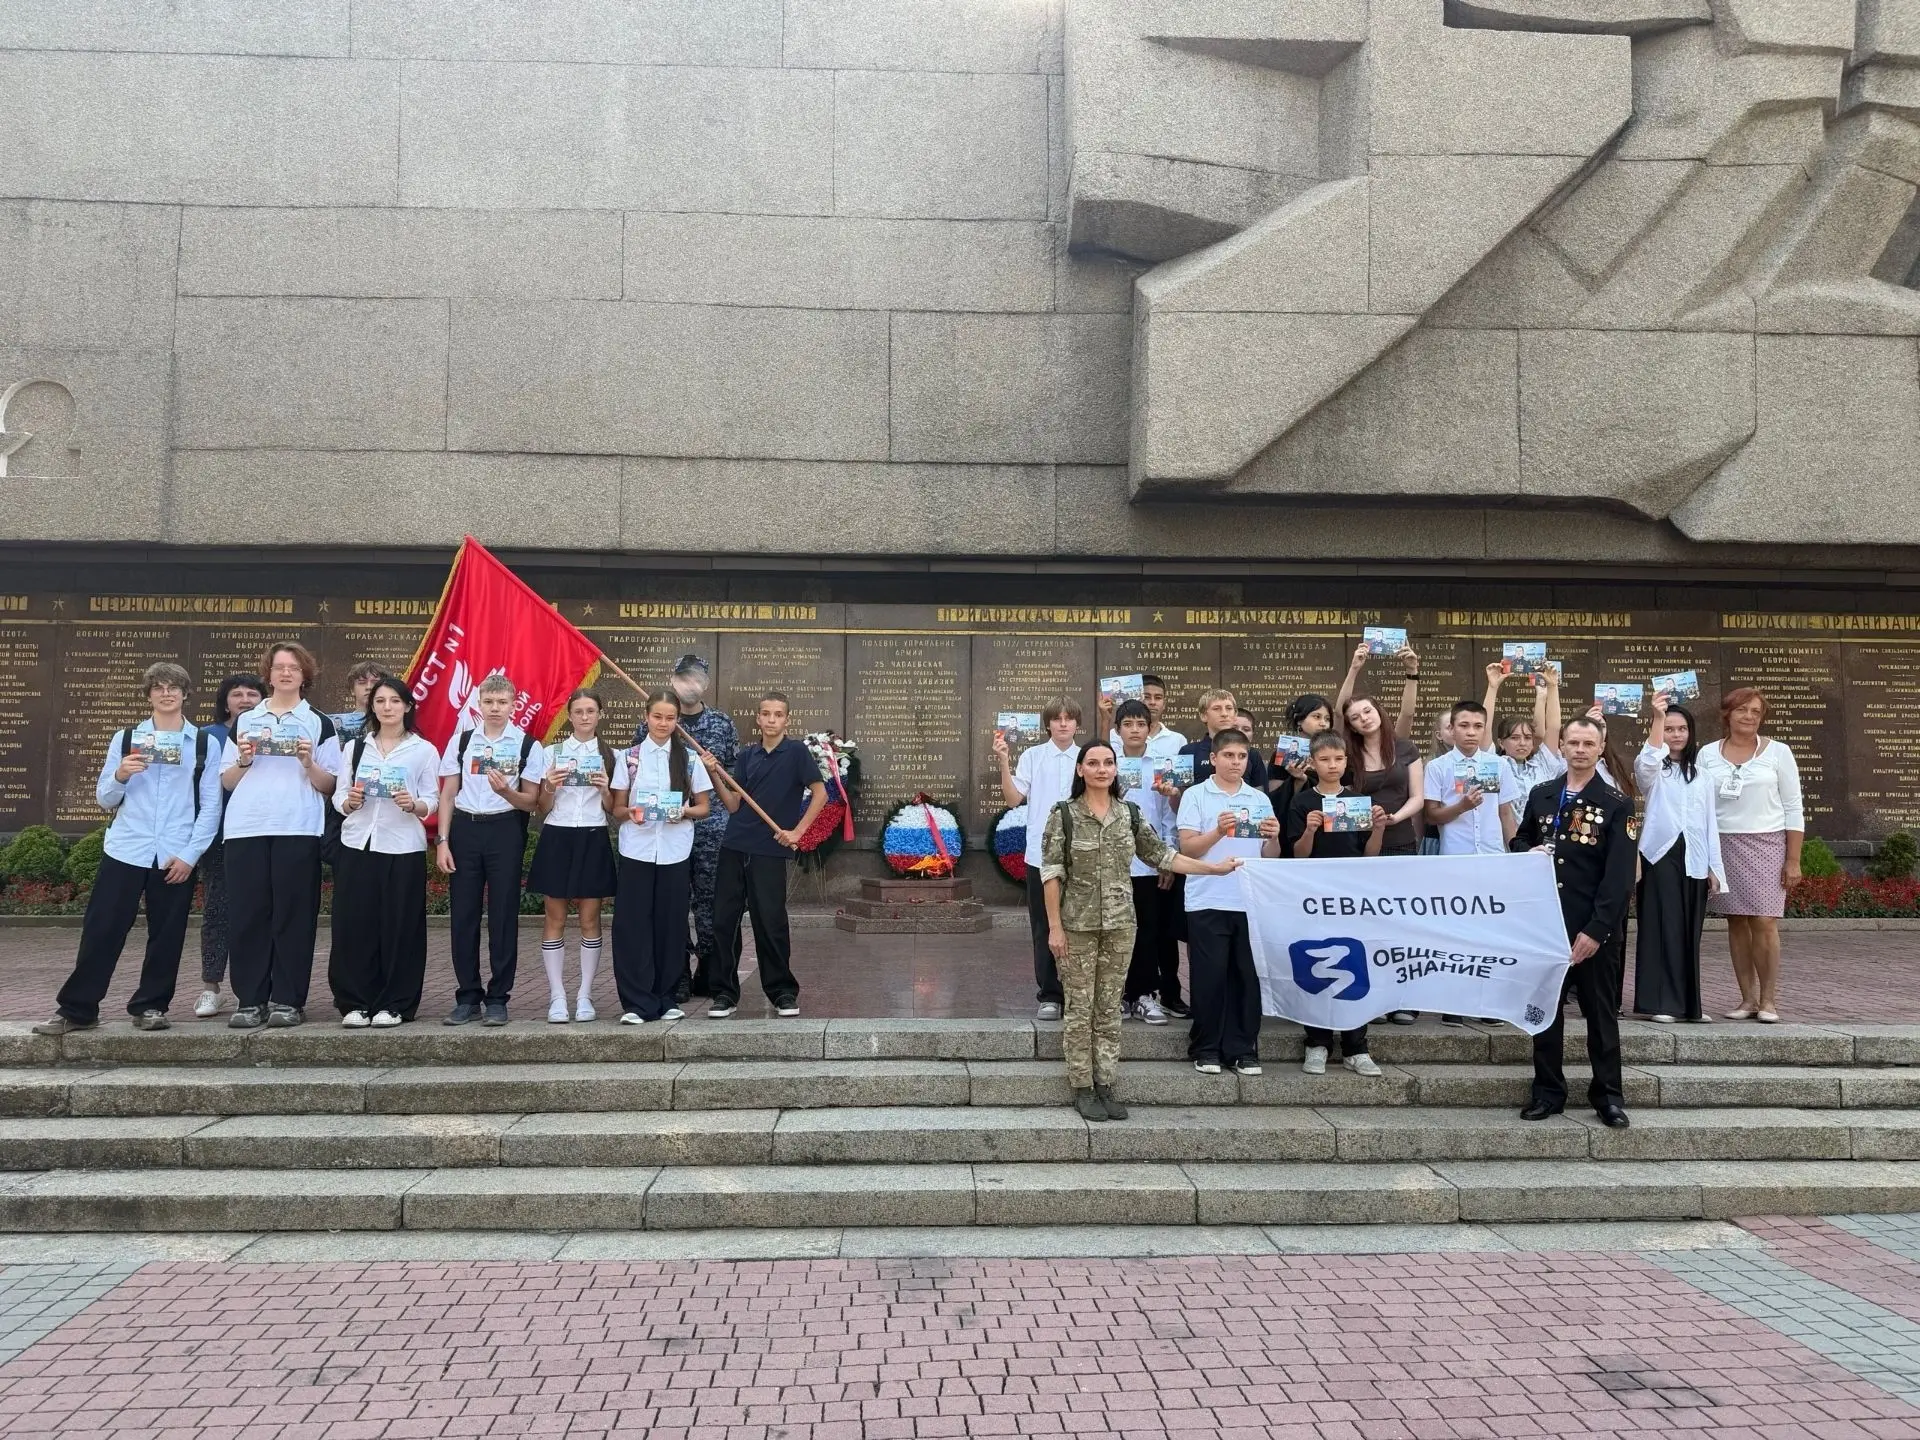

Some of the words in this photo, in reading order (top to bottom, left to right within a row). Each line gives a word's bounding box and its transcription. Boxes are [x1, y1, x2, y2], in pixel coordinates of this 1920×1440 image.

[93, 597, 234, 613] ЧЕРНОМОРСКИЙ
[245, 598, 291, 613] ФЛОТ
[357, 600, 439, 615] ЧЕРНОМ
[622, 604, 759, 619] ЧЕРНОМОРСКИЙ
[771, 606, 815, 620] ФЛОТ
[941, 608, 1054, 622] ПРИМОРСКАЯ
[1066, 609, 1127, 623] АРМИЯ
[1191, 610, 1305, 624] ПРИМОРСКАЯ
[1443, 611, 1557, 626] ПРИМОРСКАЯ
[1567, 612, 1627, 626] АРМИЯ
[1822, 615, 1920, 630] ОРГАНИЗАЦИ
[0, 630, 28, 638] ЕХОТА
[345, 633, 386, 641] КОРАБЛИ
[388, 633, 424, 641] ЭСКАДР
[608, 635, 697, 644] ГИДРОГРАФИЧЕСКИЙ
[110, 640, 135, 648] СИЛЫ
[862, 640, 898, 648] ПОЛЕВОЕ
[904, 640, 955, 648] УПРАВЛЕНИЕ
[1025, 640, 1074, 648] СТРЕЛКОВАЯ
[1140, 642, 1201, 650] СТРЕЛКОВАЯ
[1739, 647, 1784, 655] ГОРОДСКОЙ
[1137, 652, 1180, 660] ДИВИЗИЯ
[1262, 652, 1305, 660] ДИВИЗИЯ
[892, 661, 943, 669] ЧАПАЕВСКАЯ
[411, 651, 447, 710] ОСТ
[862, 678, 912, 686] СТРЕЛКОВАЯ
[607, 701, 646, 709] ОТДЕЛЬН
[893, 754, 943, 762] СТРЕЛКОВАЯ
[1302, 895, 1506, 916] СЕВАСТОПОЛЬ
[1373, 946, 1518, 967] ОБЩЕСТВО
[1395, 962, 1492, 984] ЗНАНИЕ
